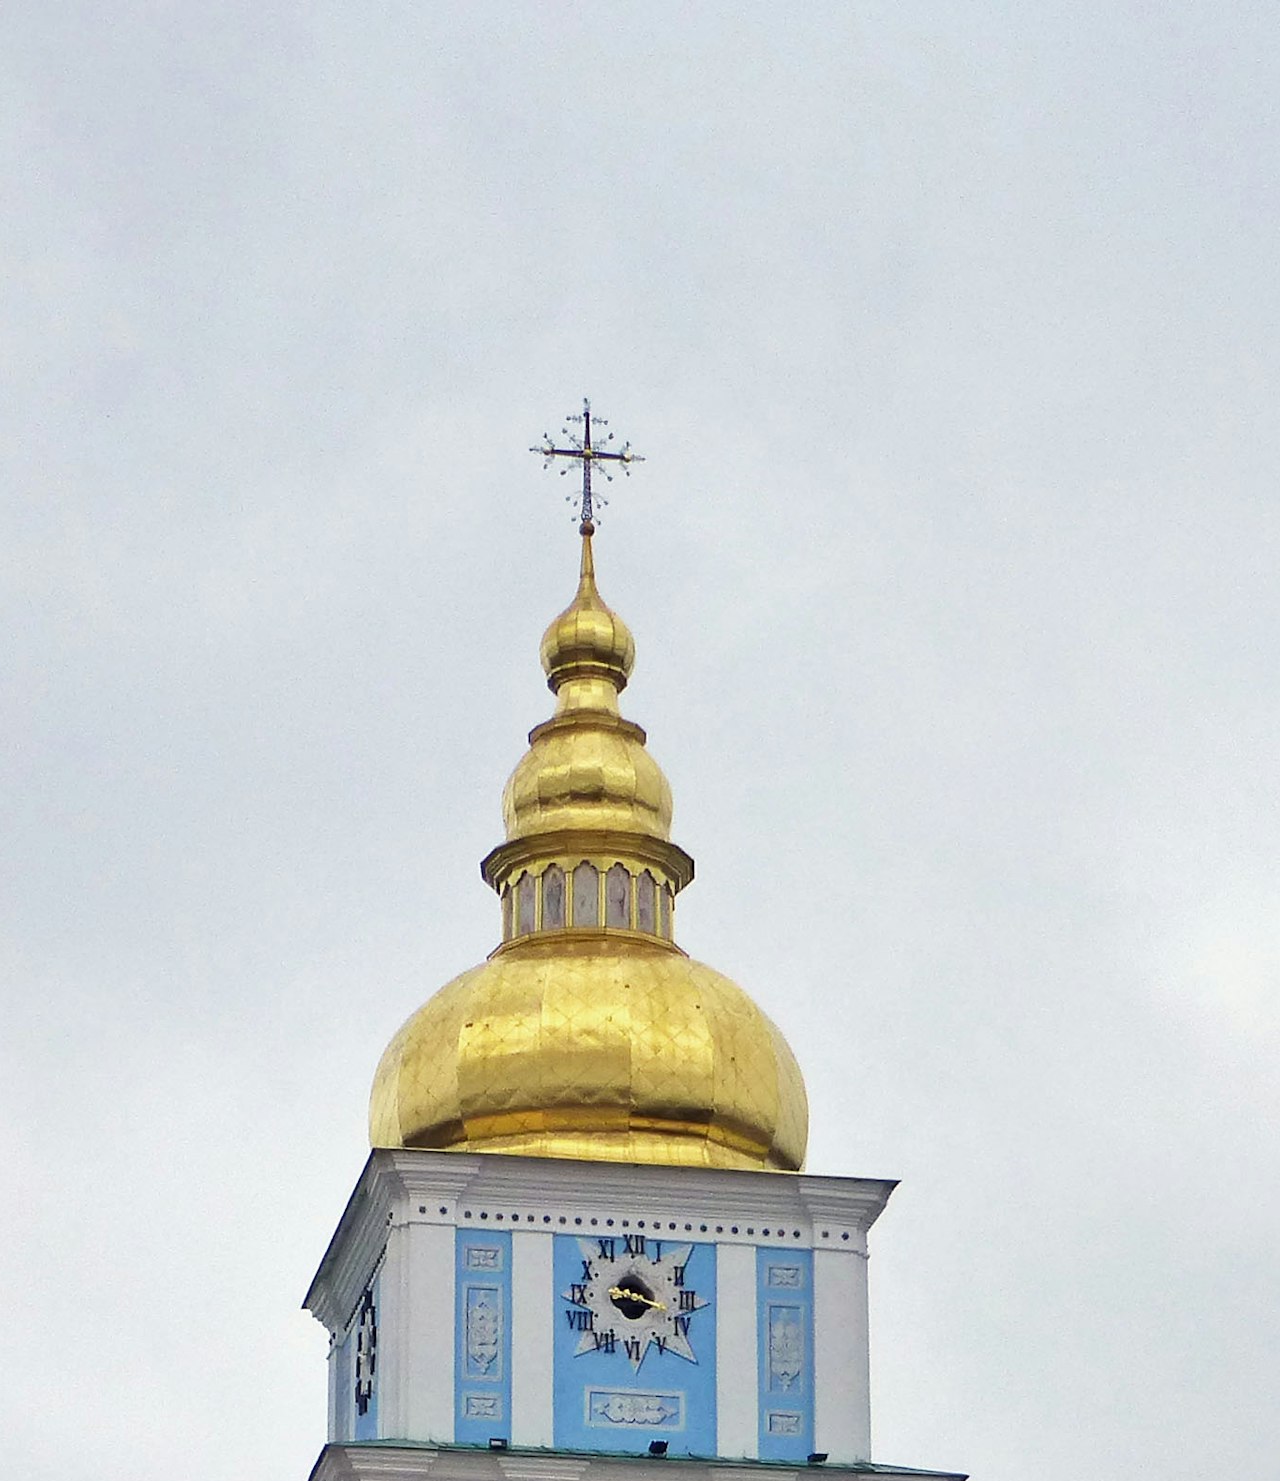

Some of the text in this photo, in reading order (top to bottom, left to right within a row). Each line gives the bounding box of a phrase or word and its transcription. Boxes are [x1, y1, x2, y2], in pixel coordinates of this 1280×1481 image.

[598, 1240, 614, 1262] XI
[623, 1234, 645, 1254] XII
[656, 1243, 661, 1262] I
[582, 1260, 592, 1280] X
[674, 1266, 684, 1286] II
[571, 1284, 587, 1304] IX
[680, 1291, 695, 1310] III
[566, 1311, 593, 1331] VIII
[674, 1317, 690, 1336] IV
[593, 1332, 615, 1353] VII
[624, 1340, 640, 1361] VI
[655, 1336, 666, 1355] V
